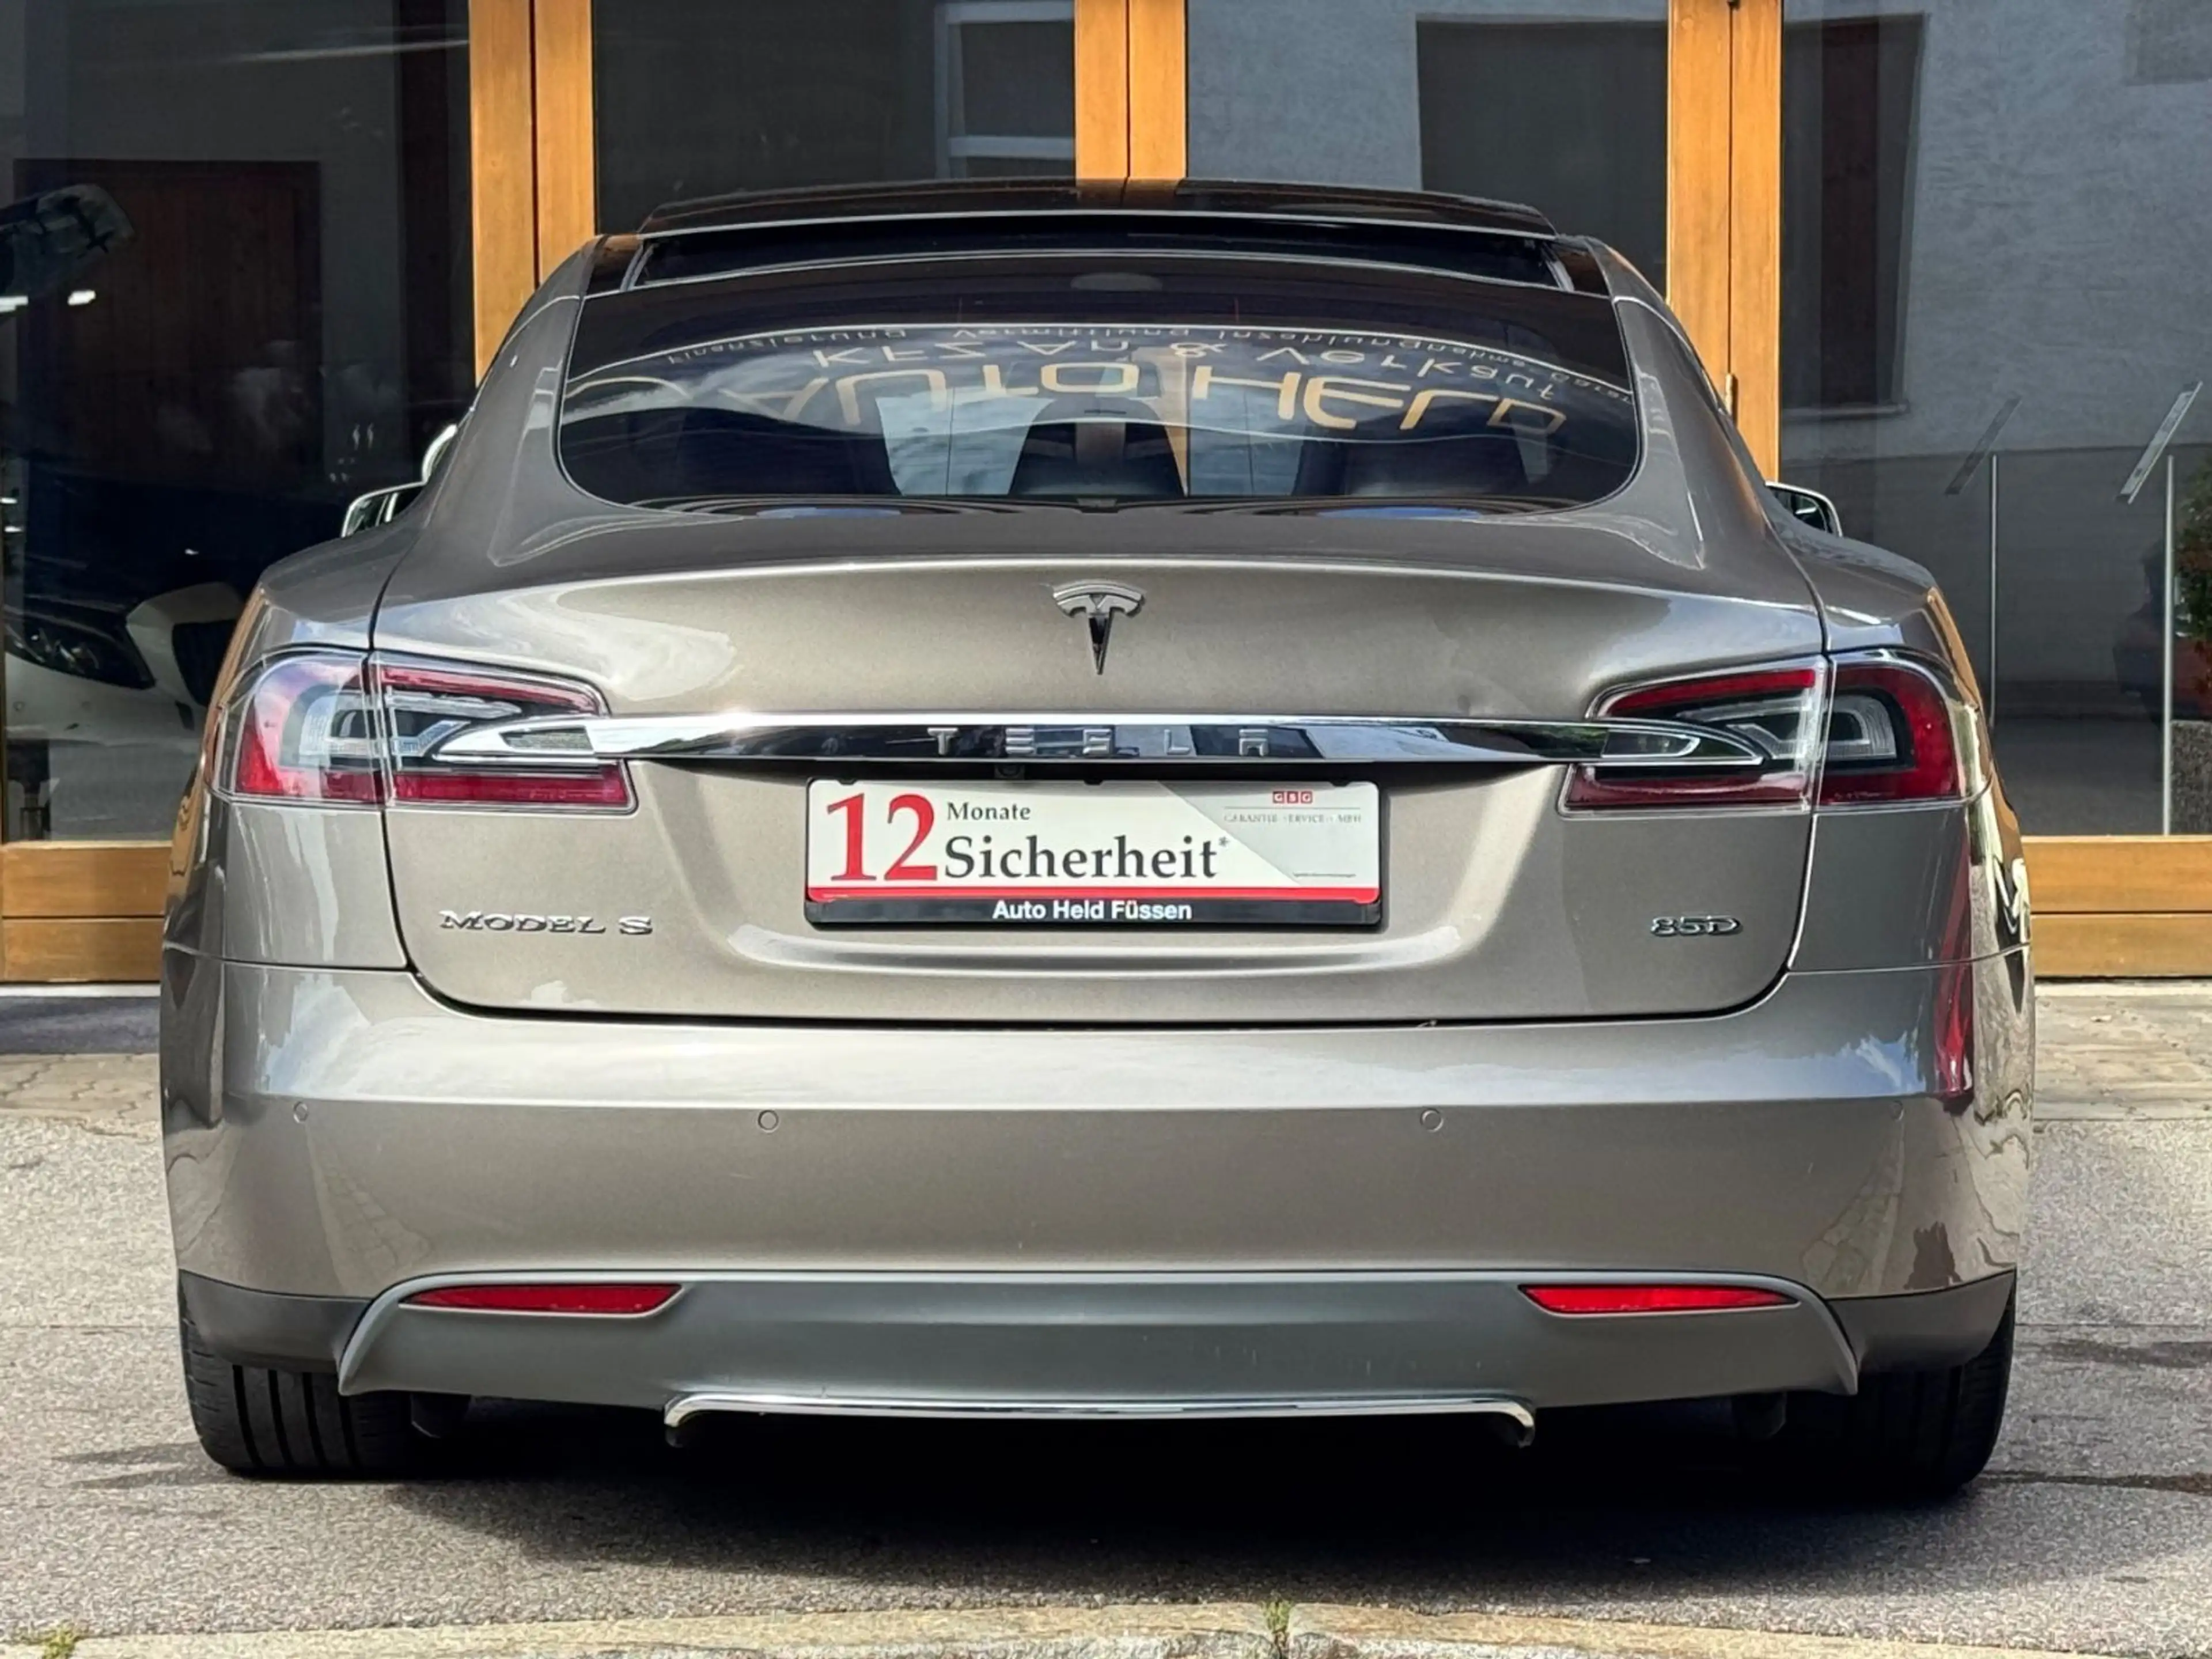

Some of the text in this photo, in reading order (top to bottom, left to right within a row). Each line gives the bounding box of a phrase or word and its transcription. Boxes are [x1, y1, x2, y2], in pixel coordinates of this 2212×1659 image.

[926, 727, 1268, 757] TESLA
[827, 793, 1031, 881] 12 Monate
[438, 910, 653, 935] MODEL S
[992, 900, 1193, 920] Auto Held Füssen
[1649, 914, 1742, 937] 85D
